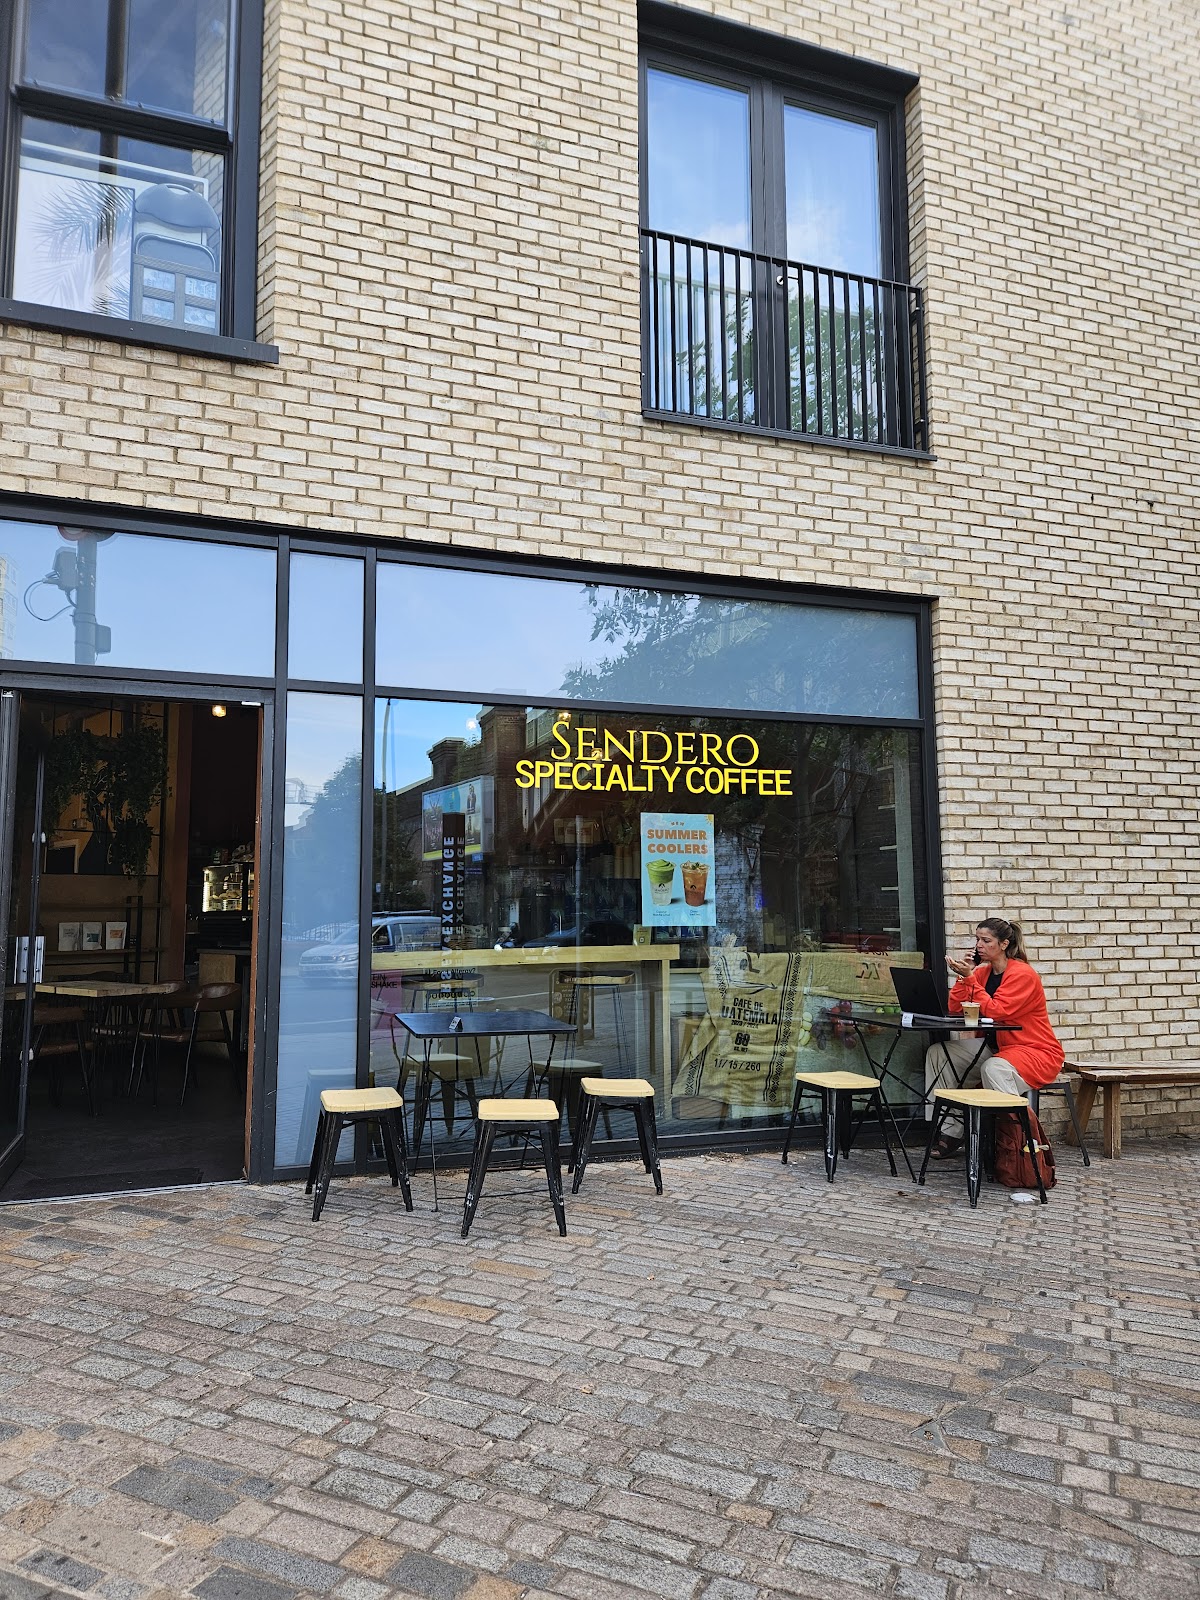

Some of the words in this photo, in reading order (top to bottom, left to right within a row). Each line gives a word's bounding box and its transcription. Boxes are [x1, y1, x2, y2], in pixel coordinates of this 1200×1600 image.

[551, 720, 760, 767] SENDERO
[515, 760, 681, 792] SPECIALTY
[686, 767, 793, 796] COFFEE
[647, 829, 708, 840] SUMMER
[647, 843, 709, 854] COOLERS
[754, 1001, 763, 1012] DE
[721, 1005, 778, 1025] UATEMALA
